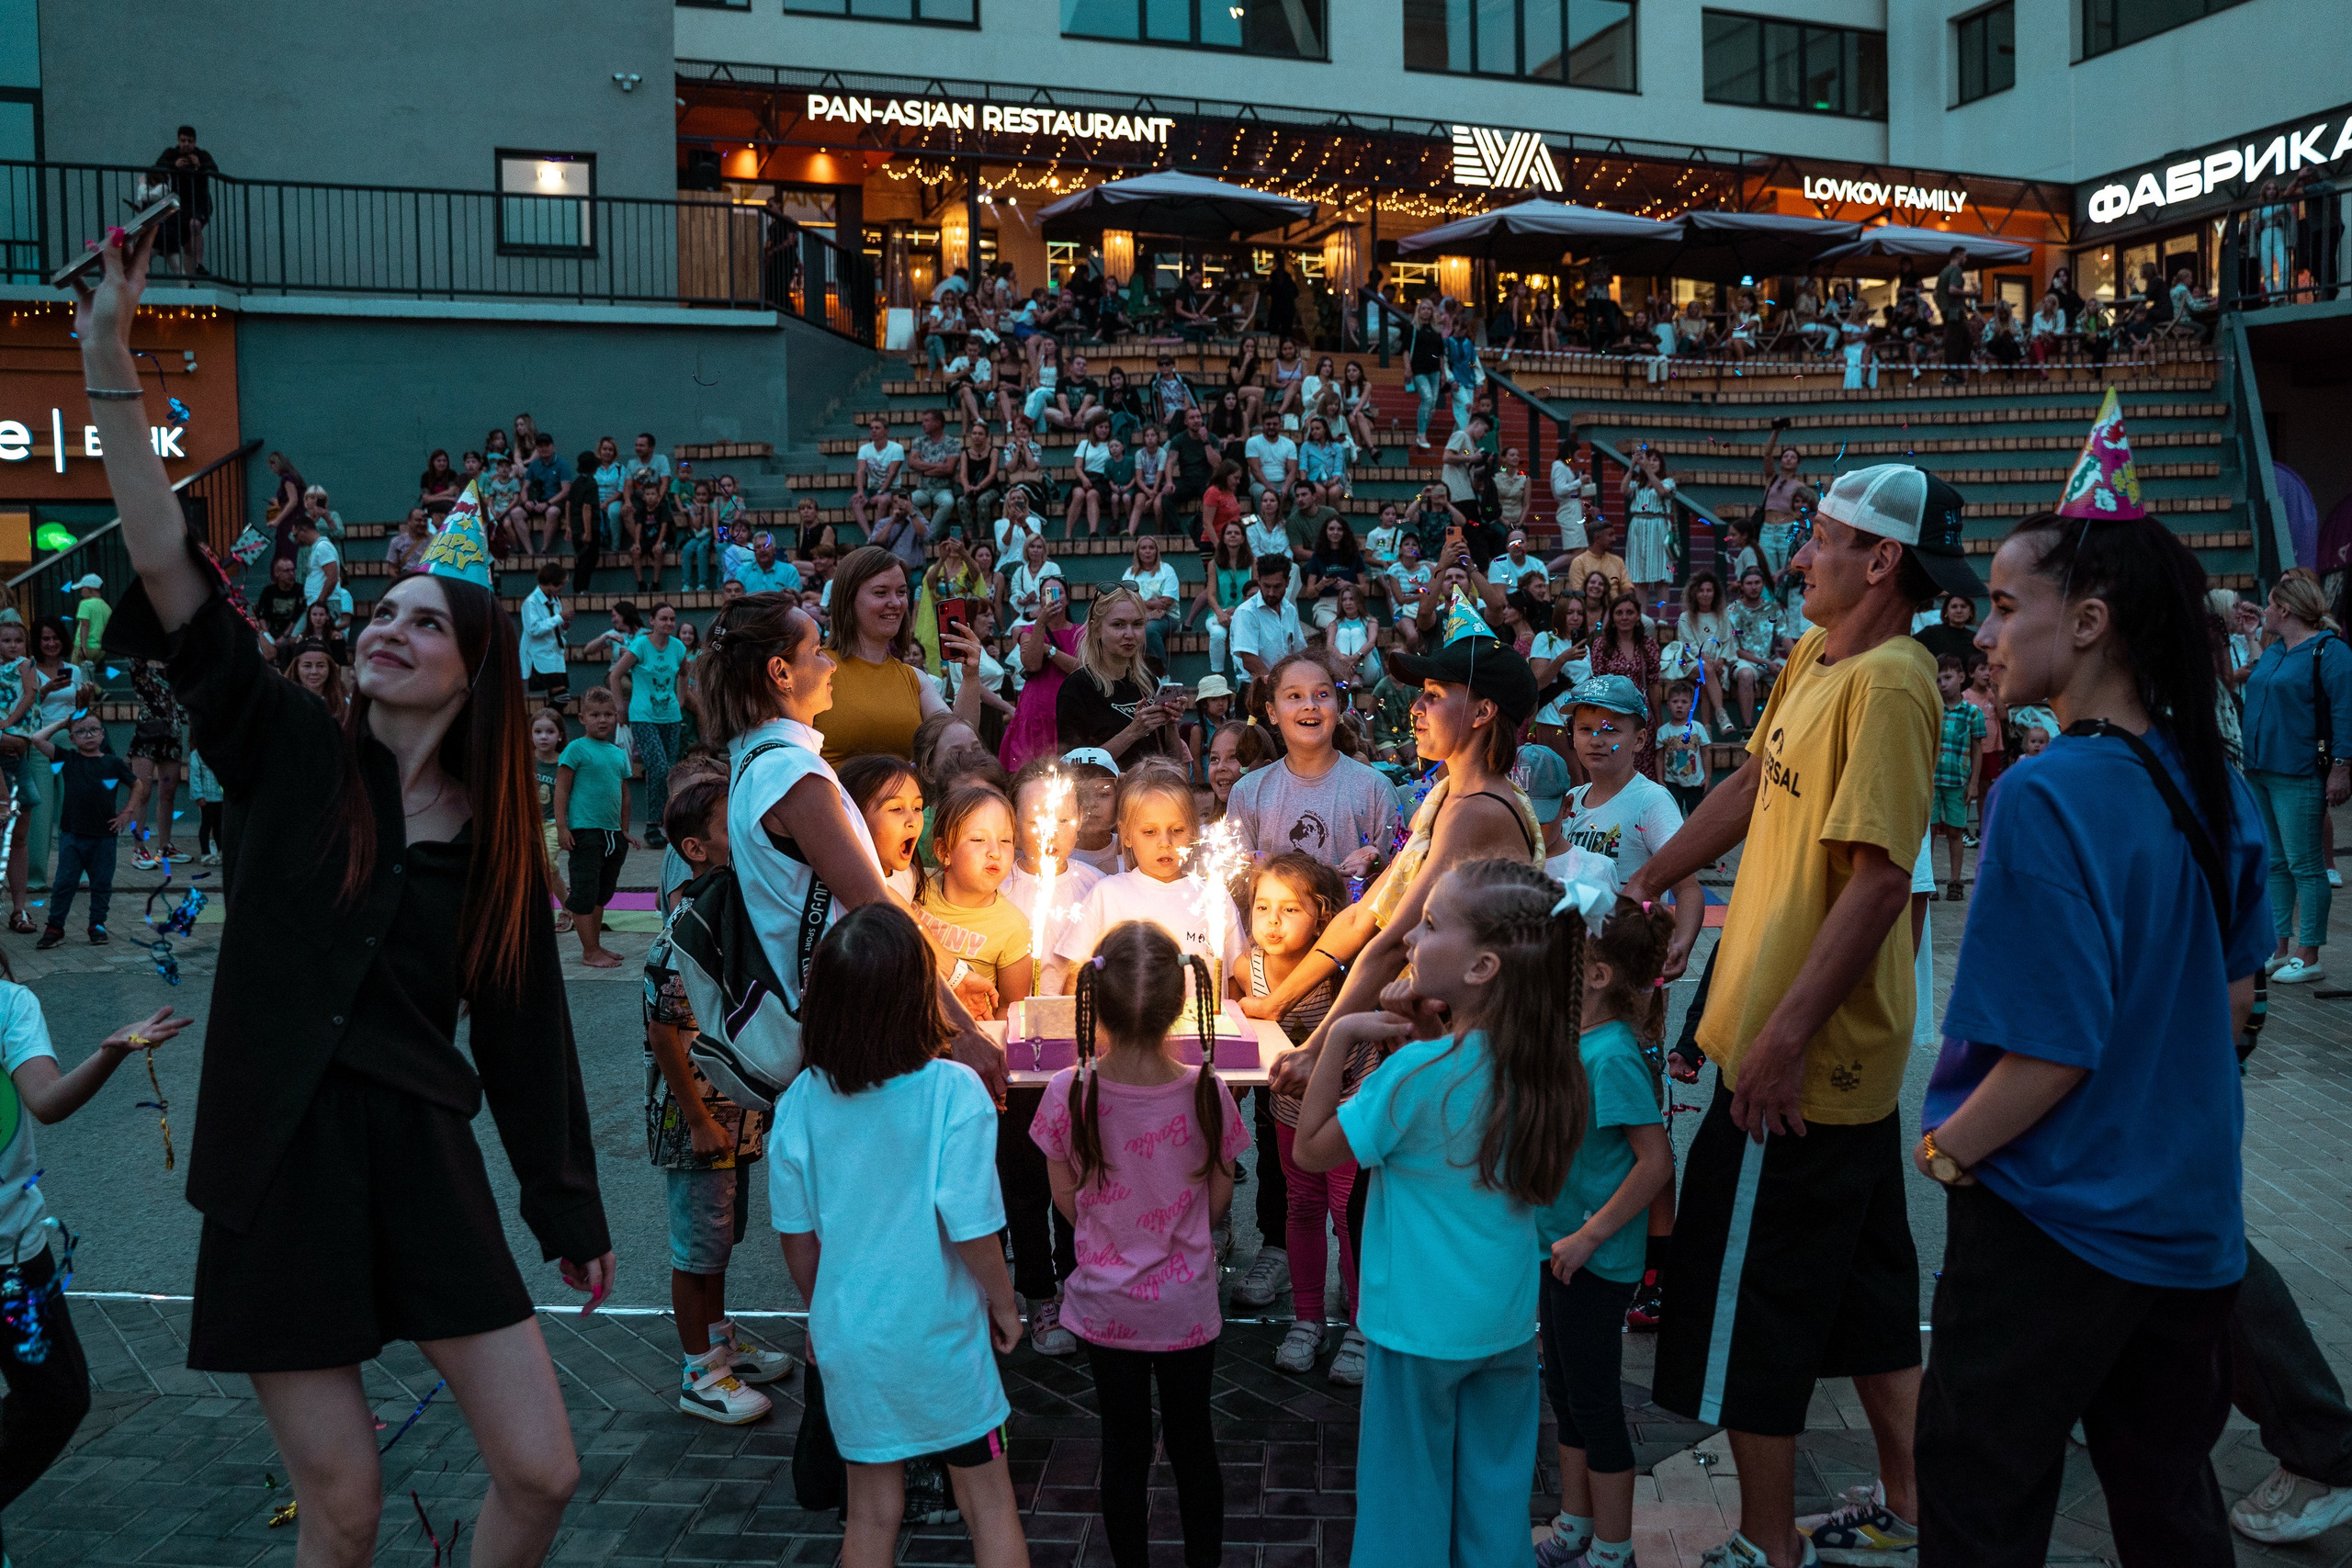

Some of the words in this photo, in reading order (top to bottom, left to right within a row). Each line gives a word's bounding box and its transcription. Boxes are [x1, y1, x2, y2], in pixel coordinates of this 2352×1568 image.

[807, 94, 975, 131] PAN-ASIAN
[982, 105, 1174, 143] RESTAURANT
[1804, 175, 1892, 206] LOVKOV
[1894, 185, 1968, 213] FAMILY
[1124, 1113, 1192, 1159] Barbie
